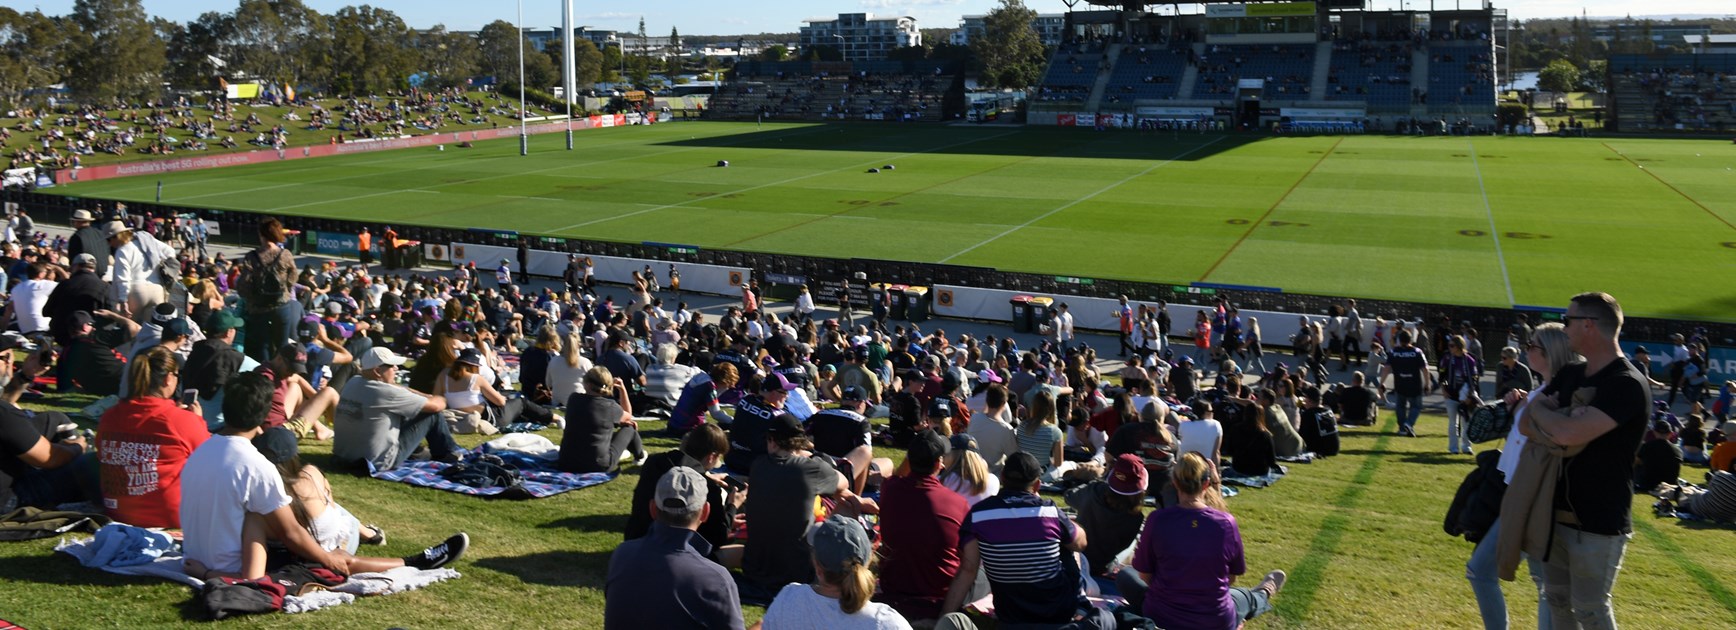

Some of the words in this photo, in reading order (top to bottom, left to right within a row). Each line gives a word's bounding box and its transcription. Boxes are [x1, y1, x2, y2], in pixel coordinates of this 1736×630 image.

[116, 162, 161, 175] Australia's
[161, 160, 180, 171] best
[181, 159, 192, 169] 5G
[193, 156, 217, 168] rolling
[218, 156, 231, 166] out
[318, 238, 340, 249] FOOD
[1708, 358, 1736, 375] AR
[739, 398, 772, 420] FUSO
[121, 441, 160, 451] DOESN'T
[128, 472, 159, 487] YOUR
